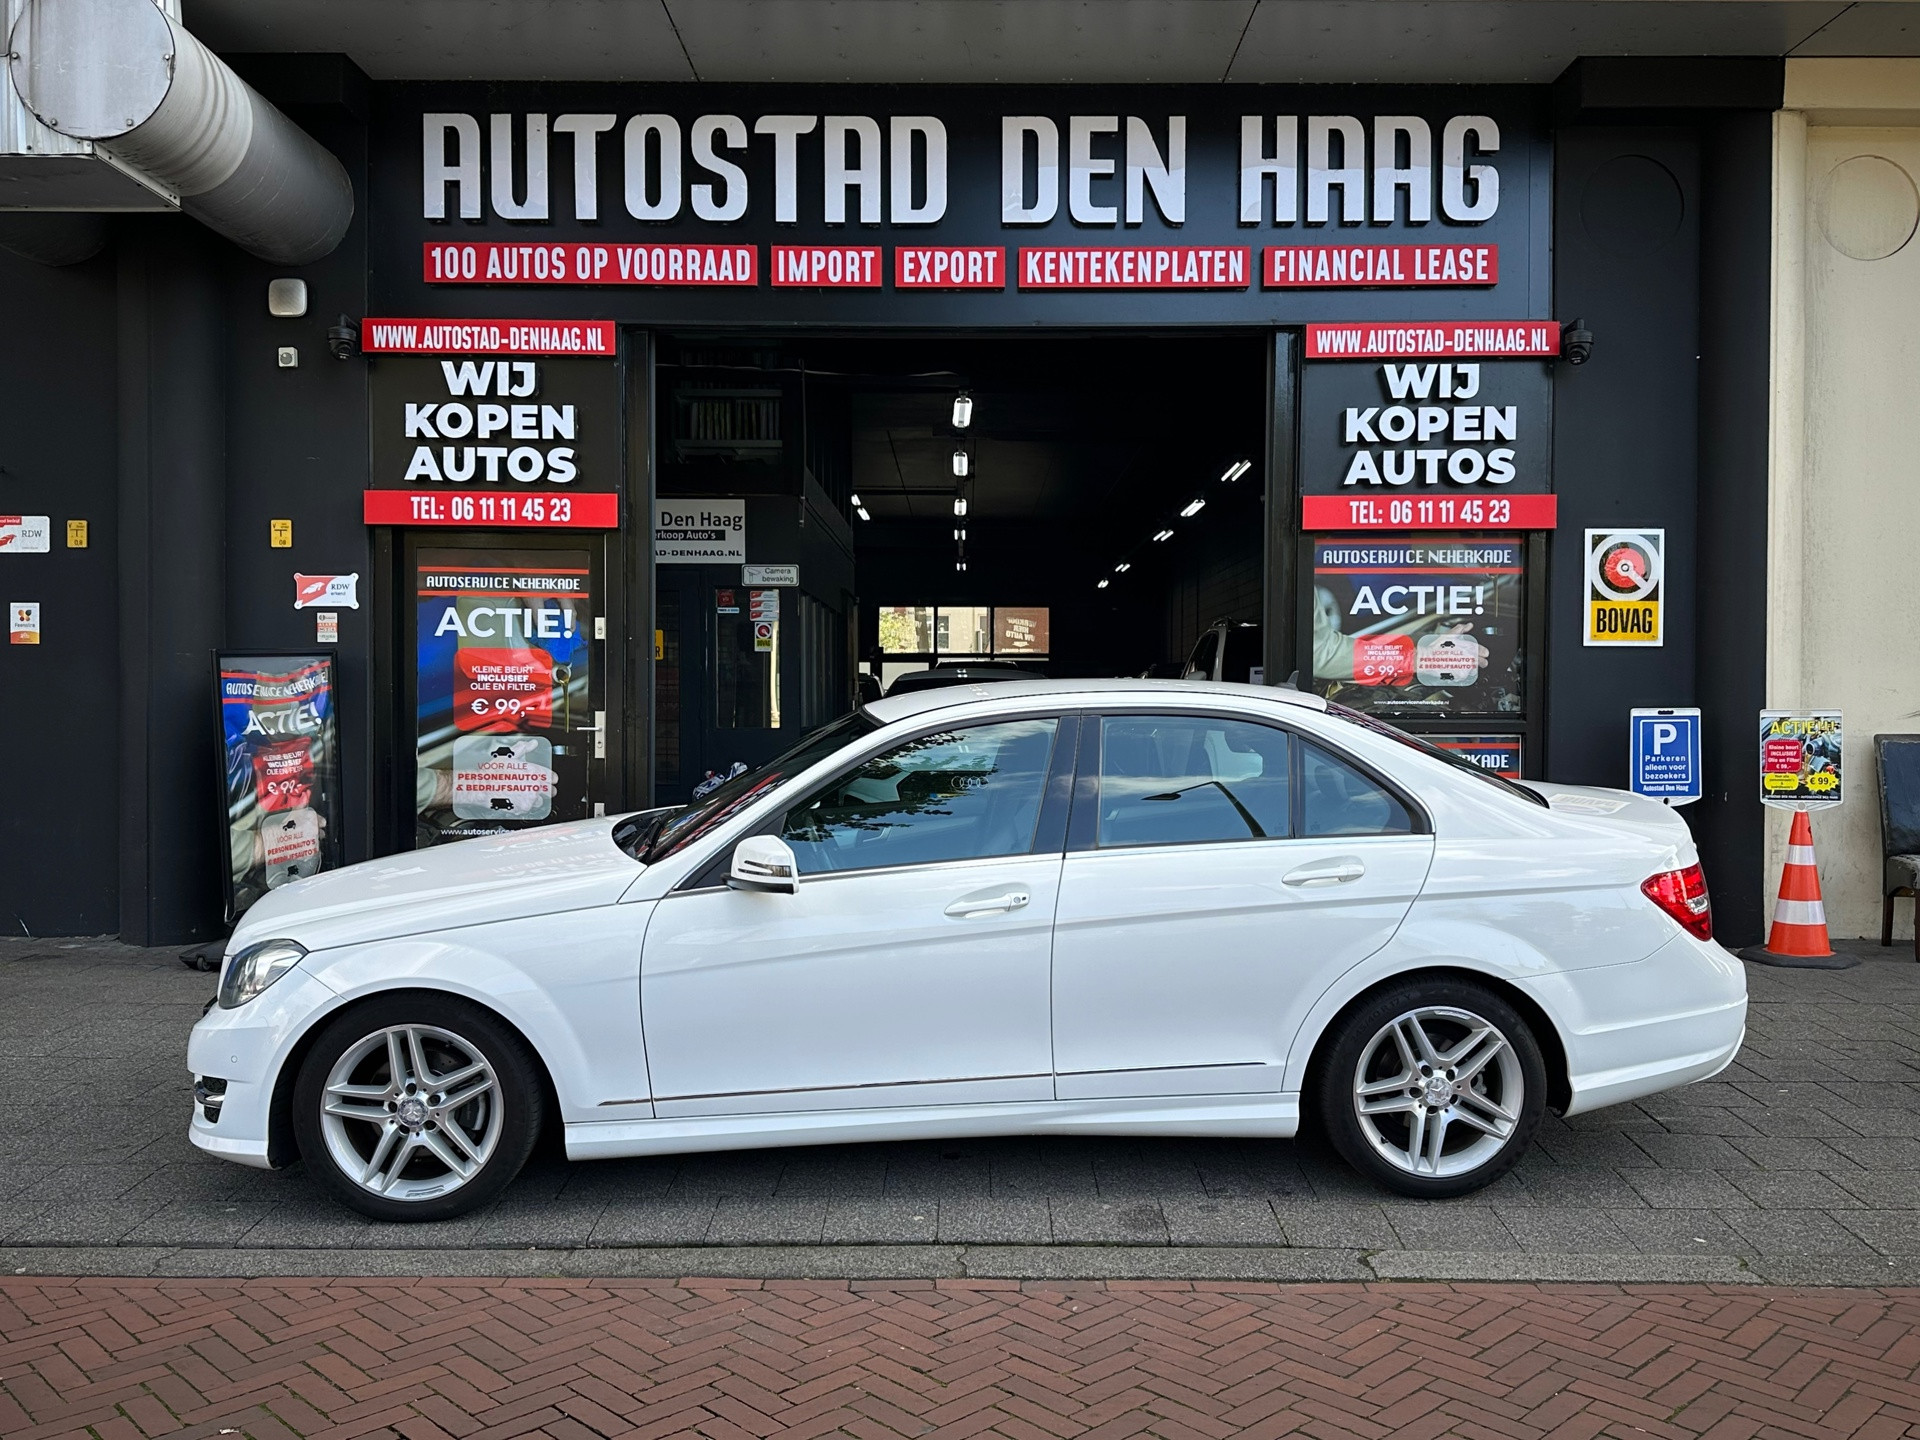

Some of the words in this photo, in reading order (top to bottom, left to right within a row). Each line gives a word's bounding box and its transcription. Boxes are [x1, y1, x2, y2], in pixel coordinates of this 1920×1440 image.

[423, 113, 948, 223] AUTOSTAD
[1002, 115, 1186, 223] DEN
[1240, 115, 1500, 222] HAAG
[432, 247, 476, 279] 100
[487, 247, 566, 280] AUTOS
[577, 247, 608, 280] OP
[618, 248, 751, 282] VOORRAAD
[778, 250, 876, 283] IMPORT
[903, 250, 997, 283] EXPORT
[1026, 250, 1244, 284] KENTEKENPLATEN
[1274, 249, 1404, 282] FINANCIAL
[1415, 248, 1489, 281] LEASE
[372, 325, 606, 351] WWW.AUTOSTAD-DENHAAG.NL
[1316, 328, 1550, 353] WWW.AUTOSTAD-DENHAAG.NL
[441, 361, 536, 397] WIJ
[1383, 364, 1480, 399] WIJ
[405, 402, 575, 439] KOPEN
[1345, 405, 1517, 442] KOPEN
[404, 446, 577, 483] AUTOS
[1344, 448, 1516, 485] AUTOS
[411, 497, 444, 520] TEL:
[451, 497, 474, 520] 06
[480, 498, 495, 520] 11
[501, 498, 516, 521] 11
[522, 498, 544, 521] 45
[550, 498, 571, 522] 23
[661, 511, 695, 526] Den
[700, 511, 743, 531] Haag
[1350, 501, 1383, 523] TEL:
[1390, 501, 1412, 523] 06
[1418, 500, 1433, 523] 11
[1439, 500, 1454, 523] 11
[1460, 500, 1483, 523] 45
[1489, 500, 1510, 522] 23
[21, 530, 43, 538] RDW
[686, 531, 716, 539] Auto's
[1323, 549, 1424, 564] AUTOSERVICE
[1427, 549, 1512, 564] NEHERKADE
[426, 576, 510, 589] AUTOSERVICE
[512, 577, 580, 590] NEHERKADE
[1350, 585, 1485, 615] ACTIE!
[434, 607, 573, 639] ACTIE!
[1596, 607, 1653, 633] BOVAG
[471, 665, 503, 673] KLEINE
[504, 665, 535, 674] BEURT
[477, 674, 529, 682] INCLUSIEF
[1364, 665, 1375, 675] €
[1378, 665, 1403, 677] 99,-
[470, 682, 491, 690] OLIE
[493, 682, 505, 690] EN
[507, 683, 536, 691] FILTER
[241, 701, 322, 736] ACTIE!
[471, 698, 489, 715] €
[495, 698, 536, 718] 99,-
[1654, 723, 1677, 755] P
[457, 773, 547, 781] PERSONENAUTO'S
[1809, 777, 1816, 785] €
